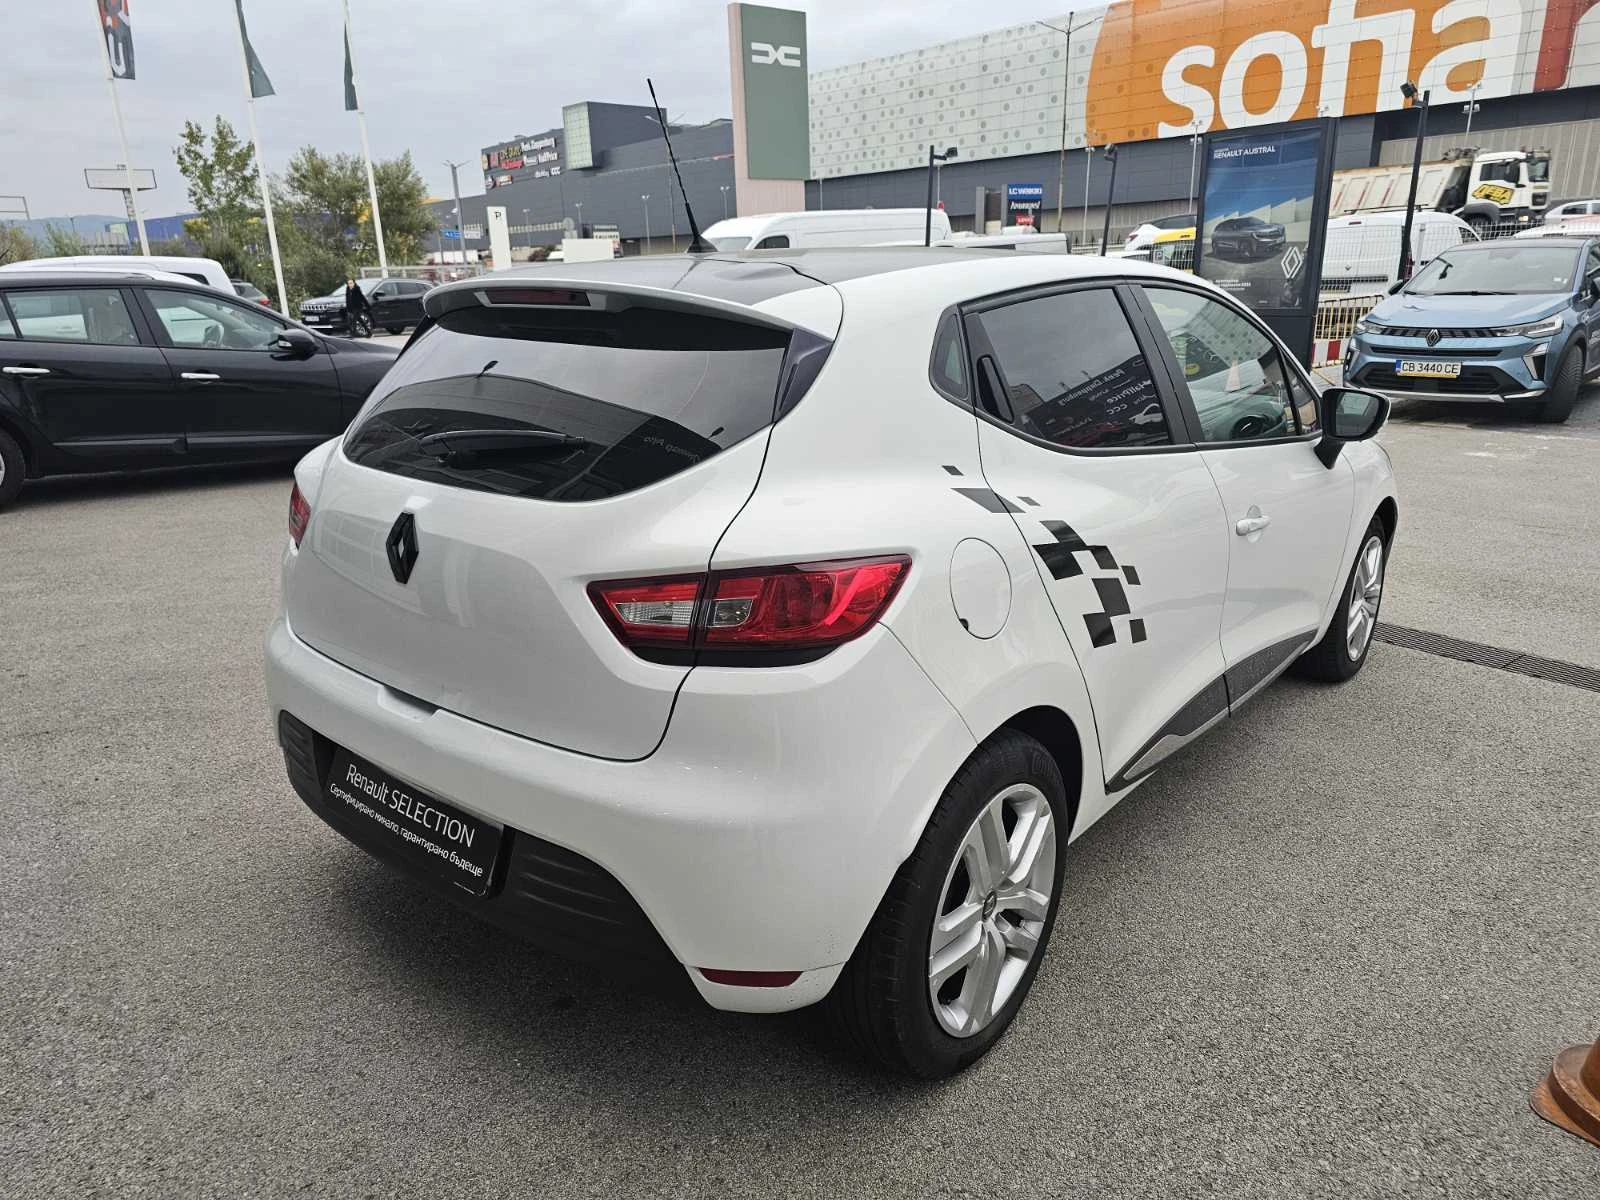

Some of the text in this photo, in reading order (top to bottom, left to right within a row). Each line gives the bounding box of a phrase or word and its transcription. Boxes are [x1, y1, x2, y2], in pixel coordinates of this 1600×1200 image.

[1213, 149, 1242, 160] RENAULT
[1243, 145, 1276, 155] AUSTRAL
[1402, 362, 1415, 372] CB
[1417, 362, 1443, 373] 3440
[1444, 363, 1459, 374] CE
[330, 783, 484, 877] Сертифицирано минало, гарантирано бъдеще
[346, 763, 476, 848] Renault SELECTION
